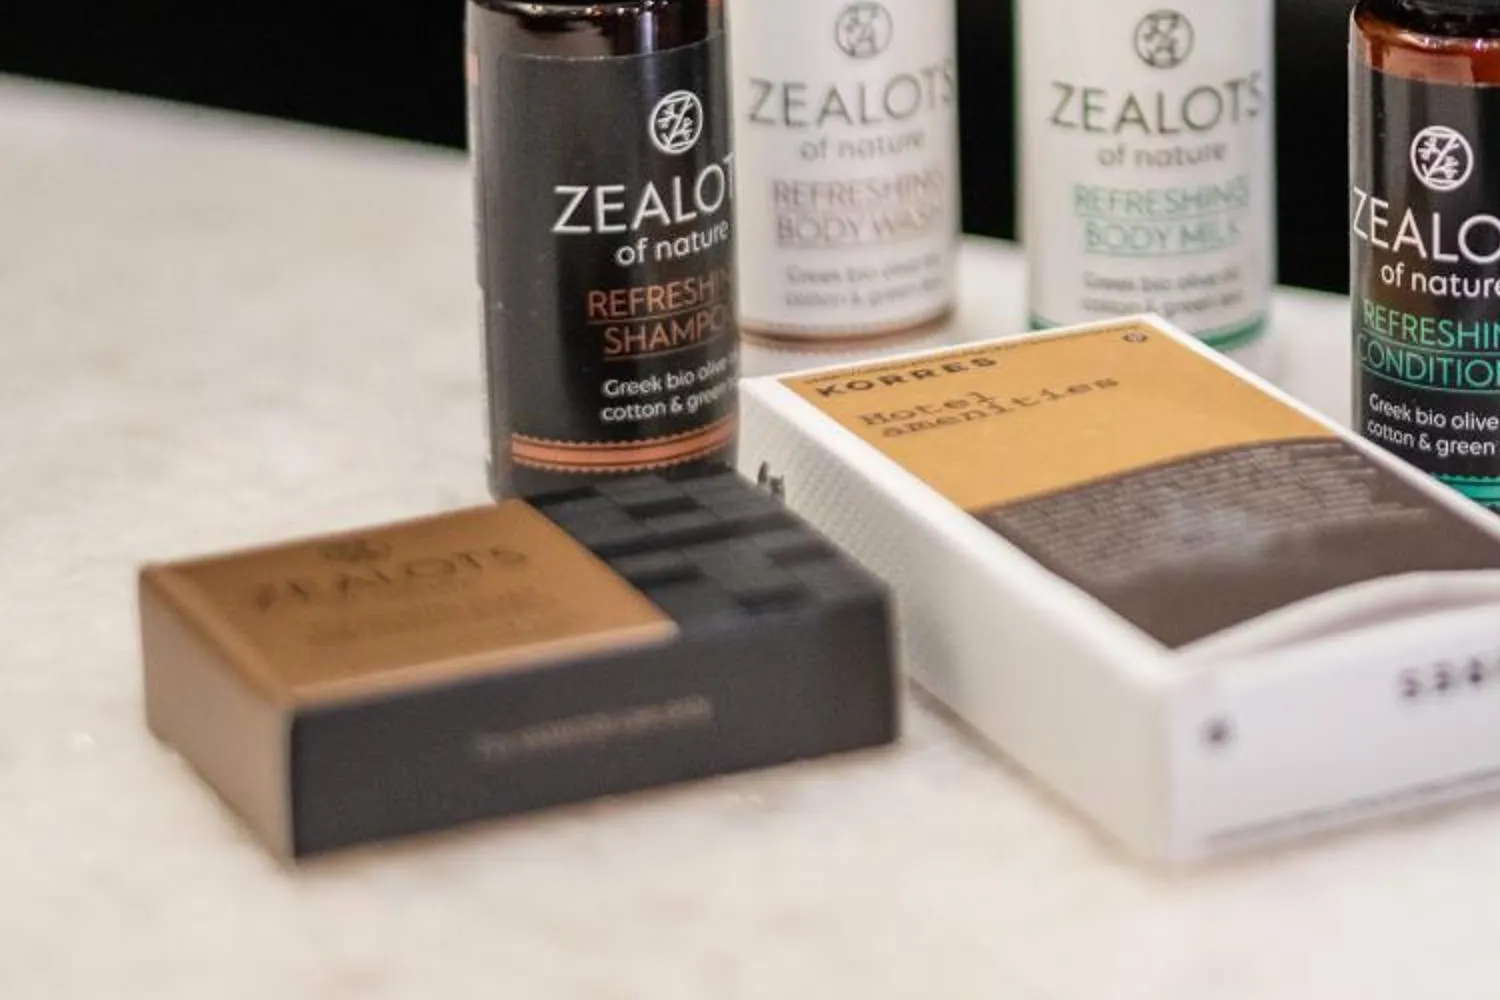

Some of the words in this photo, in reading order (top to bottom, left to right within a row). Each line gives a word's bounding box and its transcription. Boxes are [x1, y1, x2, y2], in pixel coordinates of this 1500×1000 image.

[747, 57, 953, 126] ZEALOTS
[1050, 72, 1264, 136] ZEALOTS
[801, 135, 827, 161] of
[1098, 145, 1125, 166] of
[1136, 143, 1228, 167] nature
[616, 237, 648, 267] of
[655, 219, 730, 262] nature
[1086, 220, 1168, 249] BODY
[1381, 262, 1405, 288] of
[604, 374, 662, 398] Greek
[666, 370, 696, 390] bio
[814, 356, 999, 398] KORRES
[602, 400, 667, 422] cotton
[670, 395, 684, 413] &
[857, 391, 1000, 427] Hotel
[881, 377, 1121, 438] amenities
[1369, 392, 1412, 422] Greek
[1415, 407, 1447, 429] bio
[1451, 410, 1500, 431] olive
[1367, 419, 1415, 448] cotton
[1418, 432, 1431, 451] &
[1436, 438, 1496, 457] green
